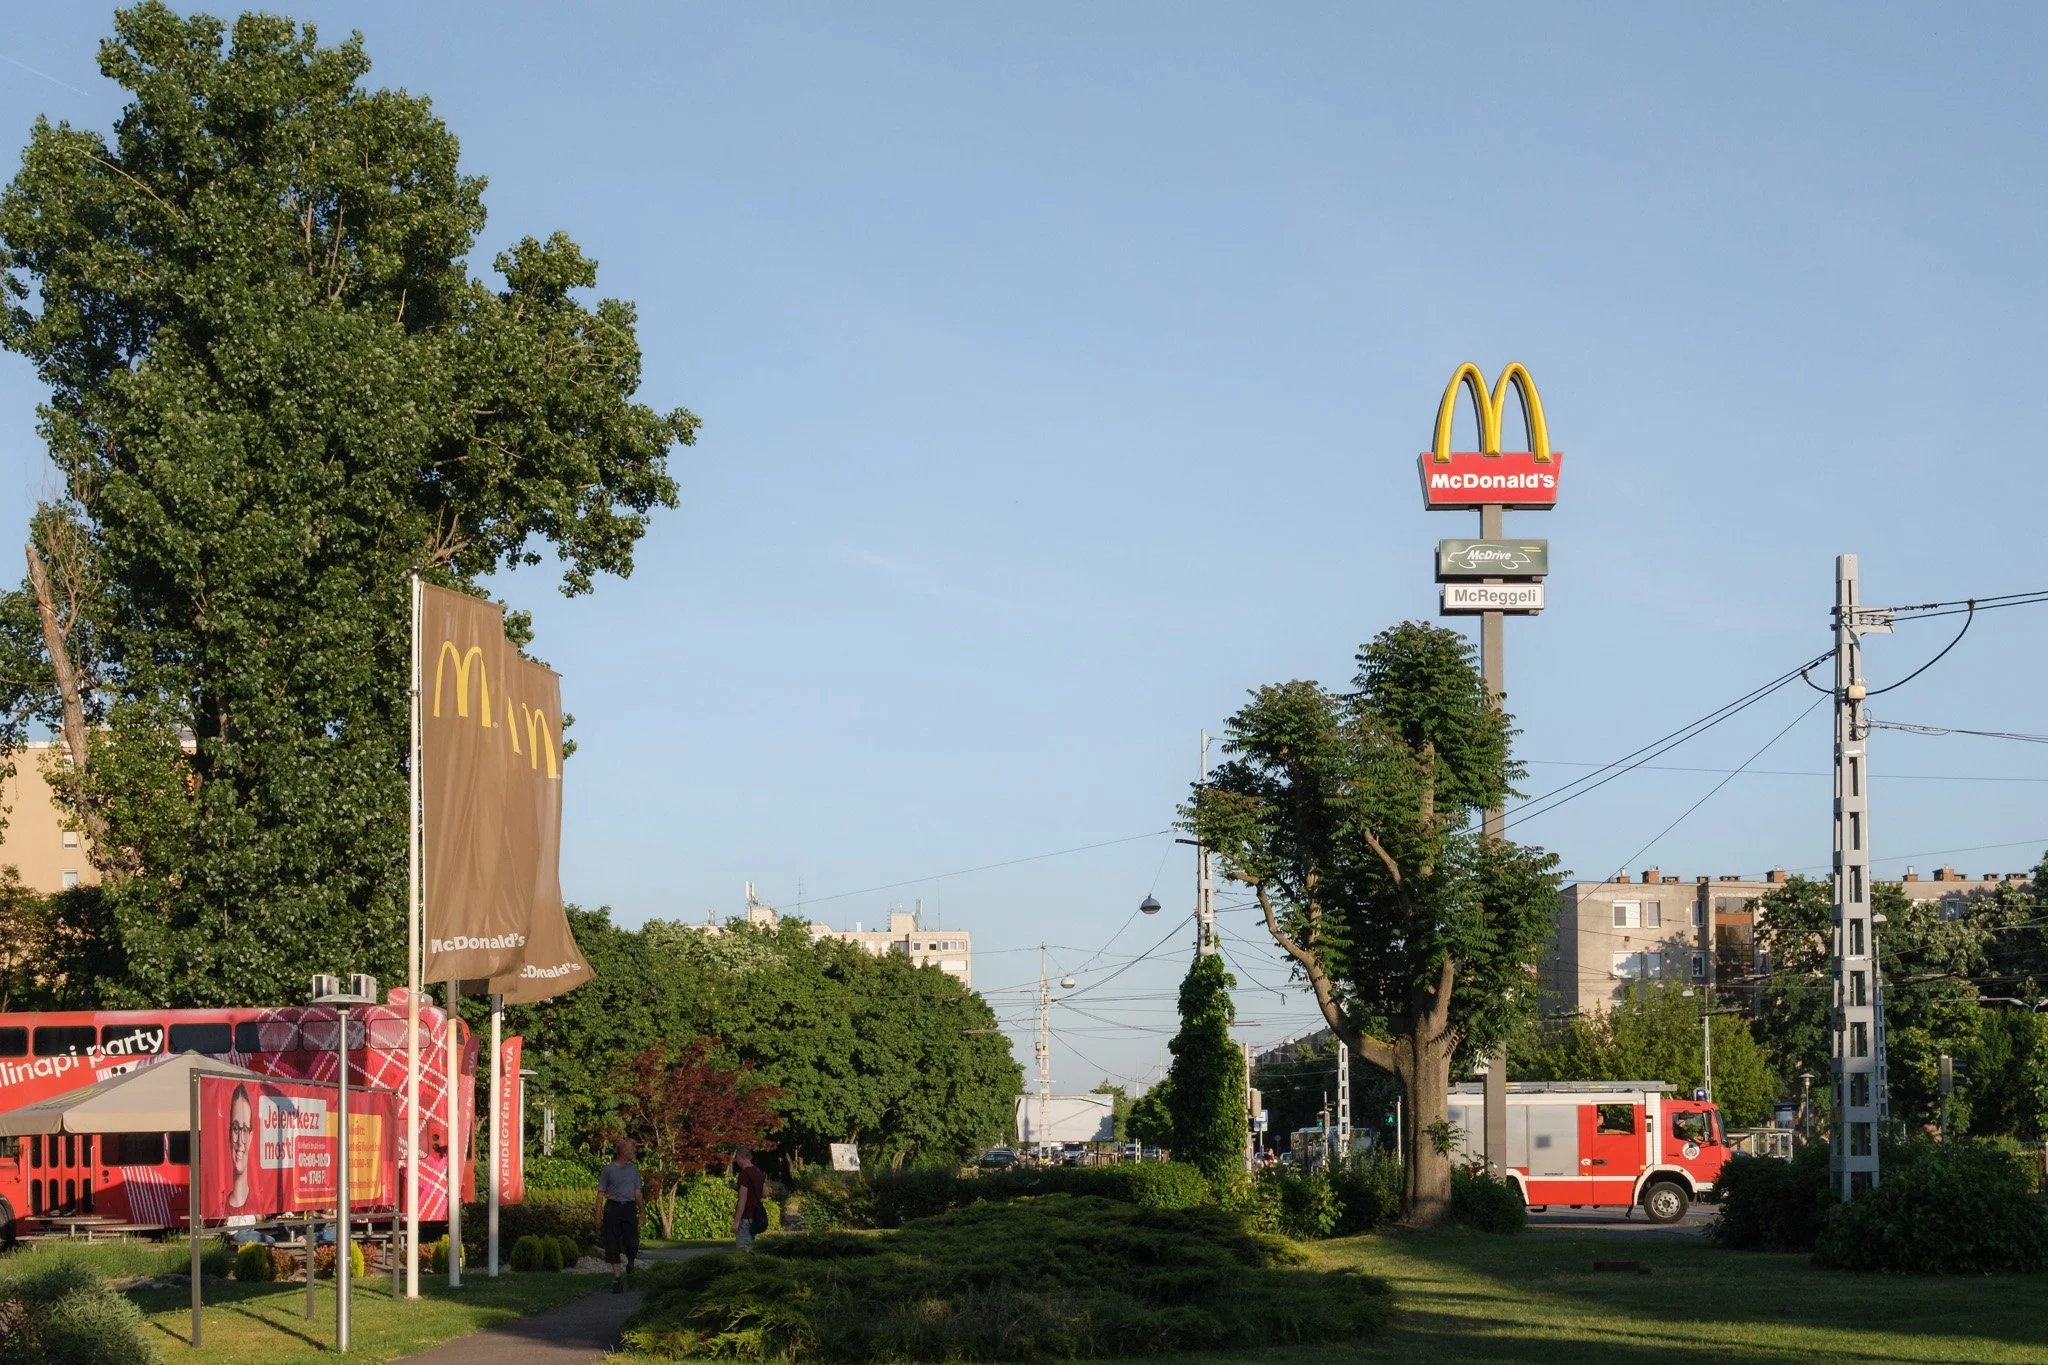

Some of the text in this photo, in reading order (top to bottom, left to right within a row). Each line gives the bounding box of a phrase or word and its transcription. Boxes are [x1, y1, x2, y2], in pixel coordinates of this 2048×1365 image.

[1431, 473, 1555, 489] McDonald's
[1467, 550, 1512, 560] McDrive
[1454, 589, 1536, 605] McReggeli
[431, 932, 526, 954] McDonald's
[0, 1029, 164, 1088] linapi party
[500, 1045, 514, 1200] A VENDÉGTÉR NYITVA
